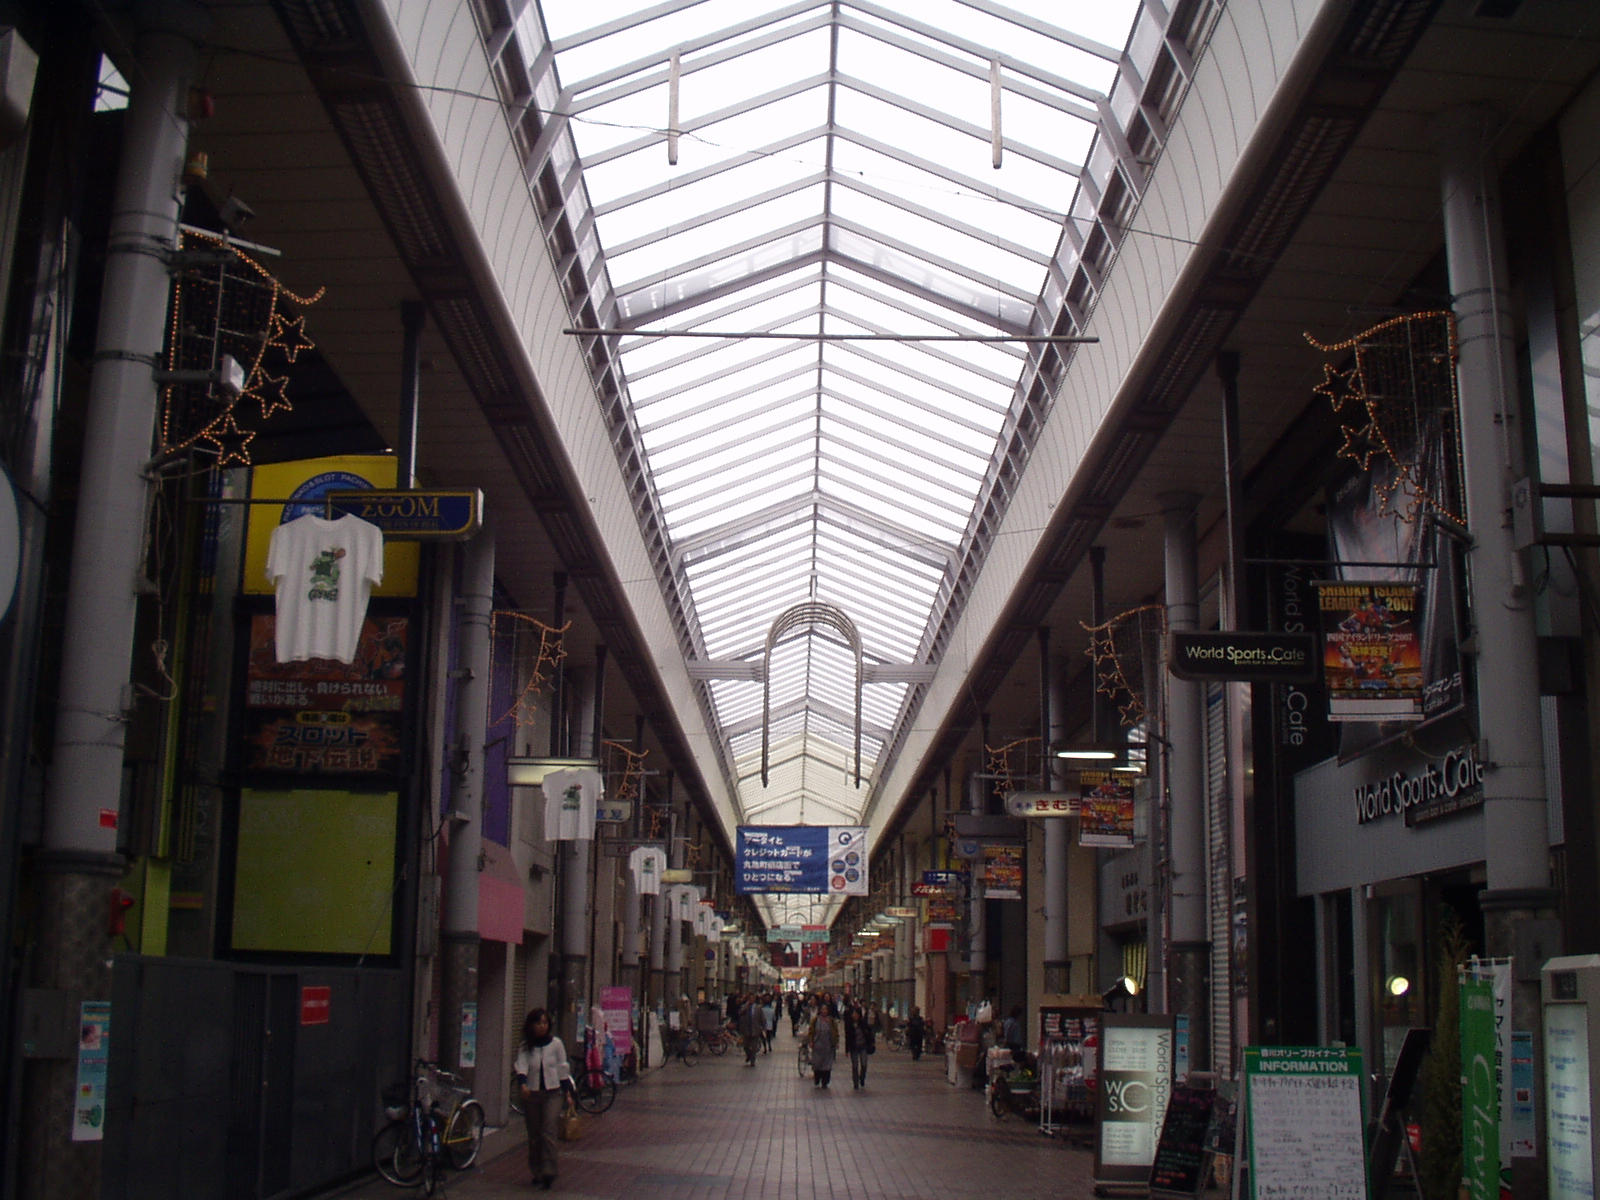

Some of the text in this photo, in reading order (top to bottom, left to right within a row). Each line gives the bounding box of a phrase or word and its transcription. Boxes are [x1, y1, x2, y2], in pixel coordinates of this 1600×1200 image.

[361, 496, 440, 517] ZOOM
[1185, 645, 1305, 665] World Sports.Cafe
[1353, 777, 1392, 823] World
[1156, 1033, 1170, 1073] World
[1259, 1061, 1349, 1072] INFORMATION
